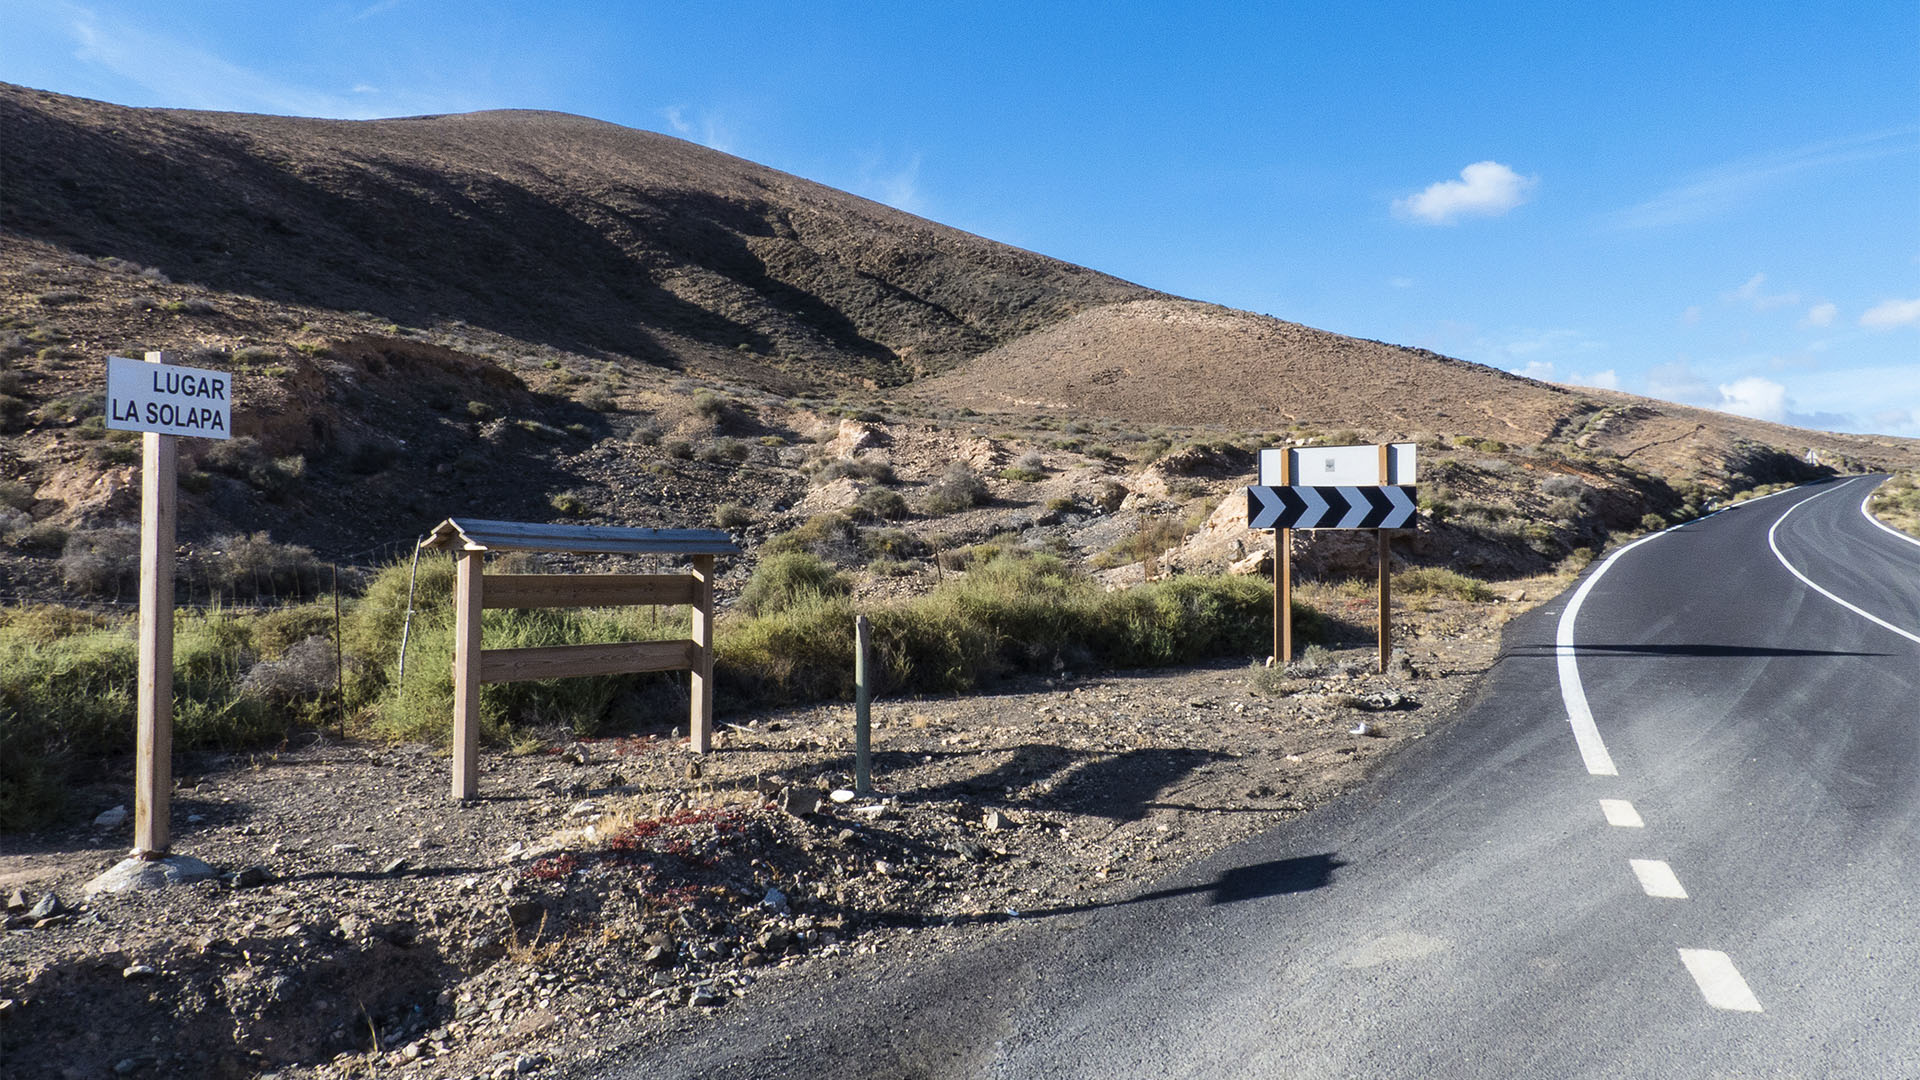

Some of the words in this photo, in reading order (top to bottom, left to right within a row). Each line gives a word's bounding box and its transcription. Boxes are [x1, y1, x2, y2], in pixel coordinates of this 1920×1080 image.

[153, 371, 225, 400] LUGAR
[112, 398, 140, 423] LA
[146, 402, 225, 431] SOLAPA
